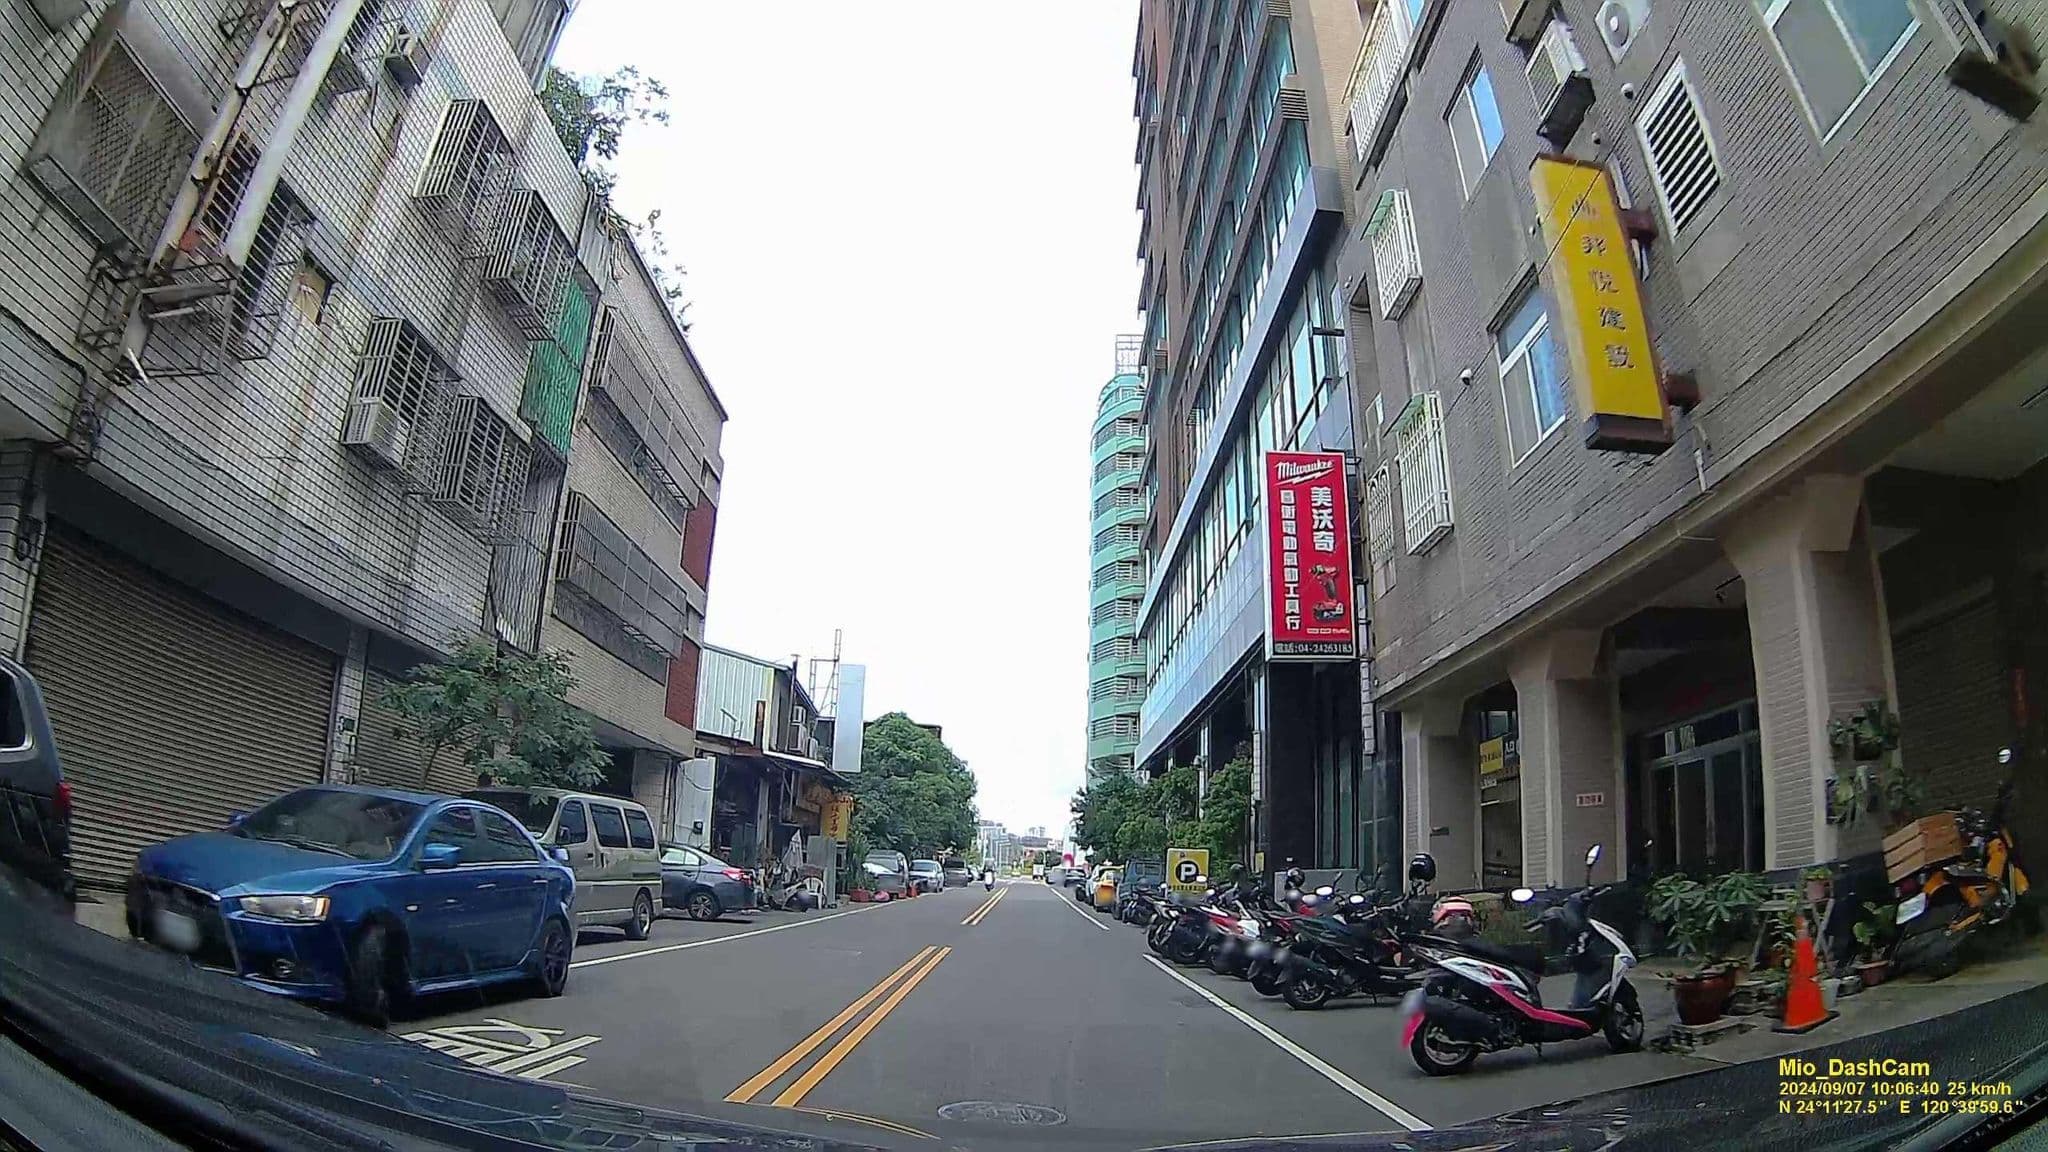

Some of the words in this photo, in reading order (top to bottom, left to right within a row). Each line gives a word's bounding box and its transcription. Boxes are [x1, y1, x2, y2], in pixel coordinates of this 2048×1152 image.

[1274, 458, 1334, 480] Milwaukee
[1310, 486, 1338, 553] 美沃奇
[1180, 863, 1197, 881] P
